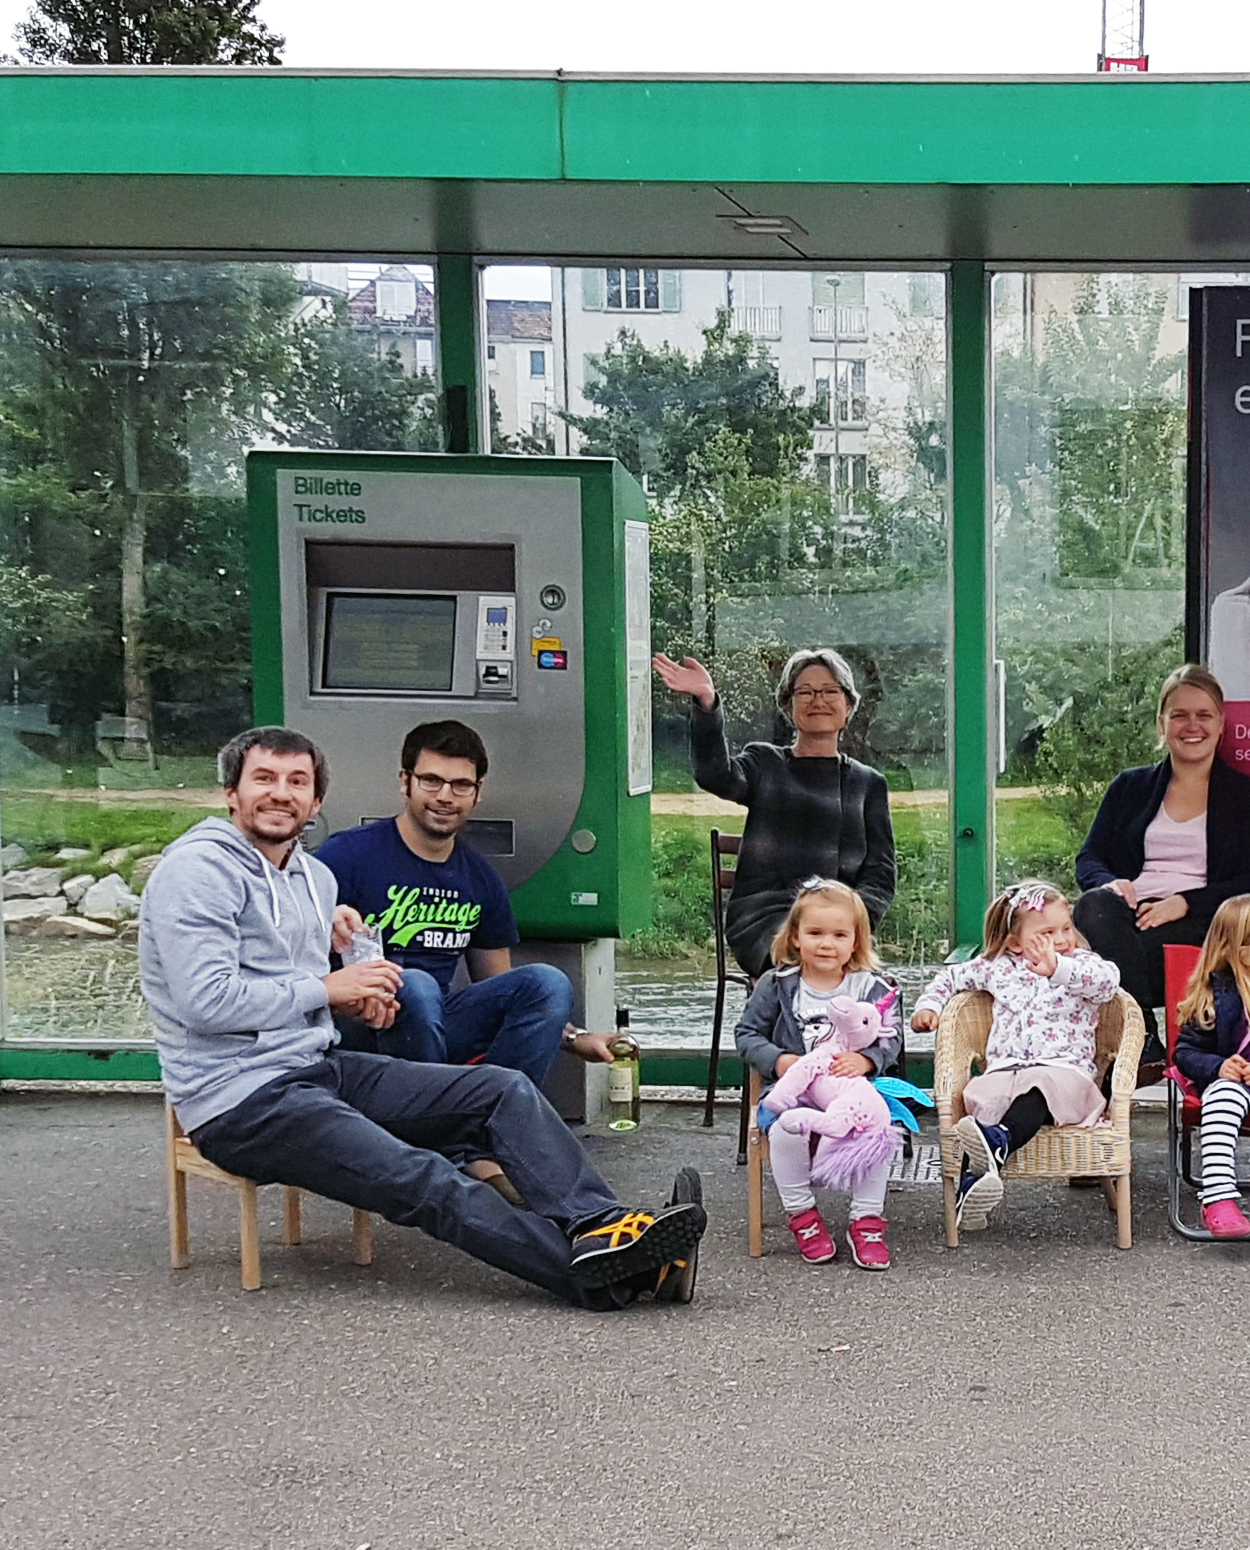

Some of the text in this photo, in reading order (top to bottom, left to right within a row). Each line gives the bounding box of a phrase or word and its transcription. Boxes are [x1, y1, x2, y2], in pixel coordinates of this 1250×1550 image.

[294, 475, 363, 497] Billette
[292, 502, 367, 525] Tickets
[379, 884, 482, 932] Heritage
